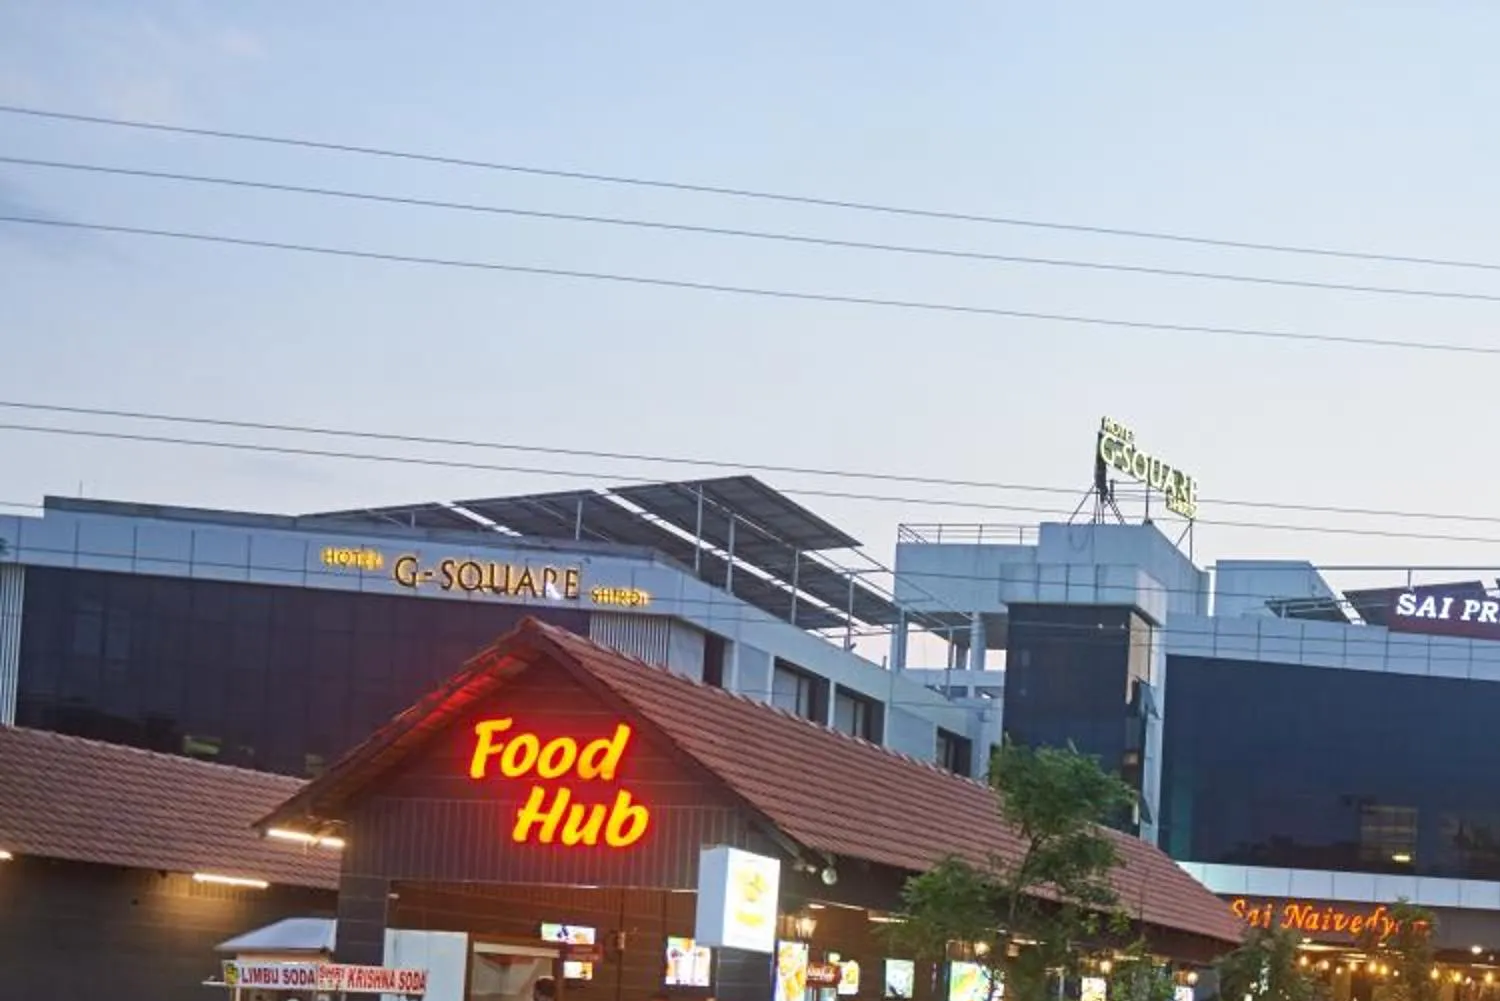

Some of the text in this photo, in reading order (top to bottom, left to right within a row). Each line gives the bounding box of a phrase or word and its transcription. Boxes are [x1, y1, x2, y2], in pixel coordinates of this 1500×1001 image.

[1101, 432, 1199, 507] G-SQUARE
[394, 556, 578, 600] G-SQUARE
[1396, 593, 1454, 619] SAI
[469, 716, 632, 781] Food
[512, 785, 650, 848] Hub
[1280, 901, 1430, 944] Naivedy
[241, 967, 279, 985] LIMBU
[283, 968, 315, 986] SODA
[399, 969, 426, 991] SODA
